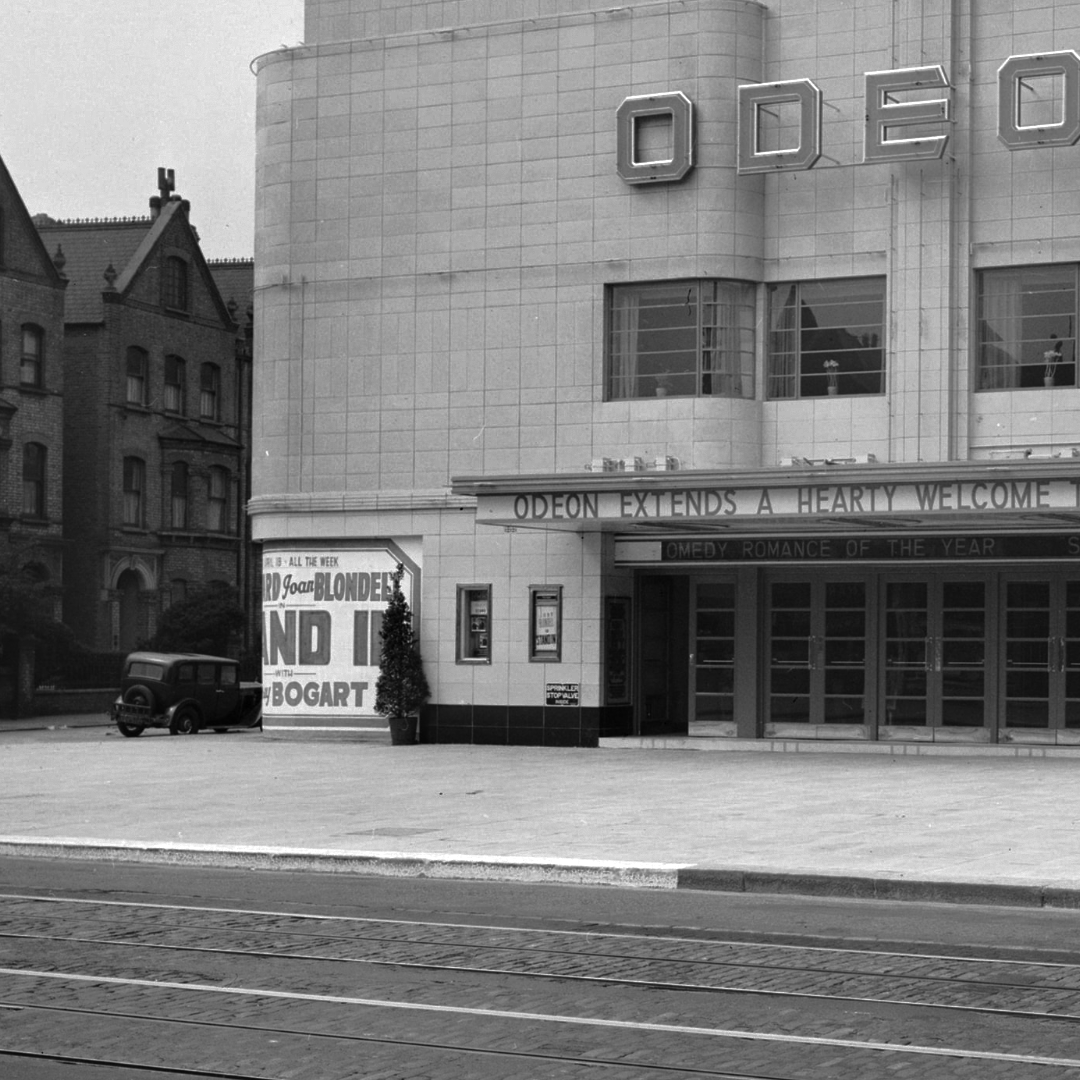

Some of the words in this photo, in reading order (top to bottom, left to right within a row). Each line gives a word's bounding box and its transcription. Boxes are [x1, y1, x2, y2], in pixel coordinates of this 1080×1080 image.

[513, 492, 599, 520] ODEON
[620, 489, 737, 518] EXTENDS
[757, 488, 774, 515] A
[798, 483, 896, 514] HEARTY
[916, 480, 1050, 511] WELCOME
[743, 540, 831, 558] ROMANCE
[846, 539, 871, 557] OF
[887, 538, 925, 557] THE
[942, 538, 996, 556] YEAR
[289, 556, 302, 567] ALL
[305, 556, 318, 567] THE
[320, 556, 339, 567] WEEK
[282, 573, 314, 600] Joan
[275, 669, 293, 677] WITH
[272, 681, 369, 708] BOGART
[546, 684, 579, 692] SPRINKLER
